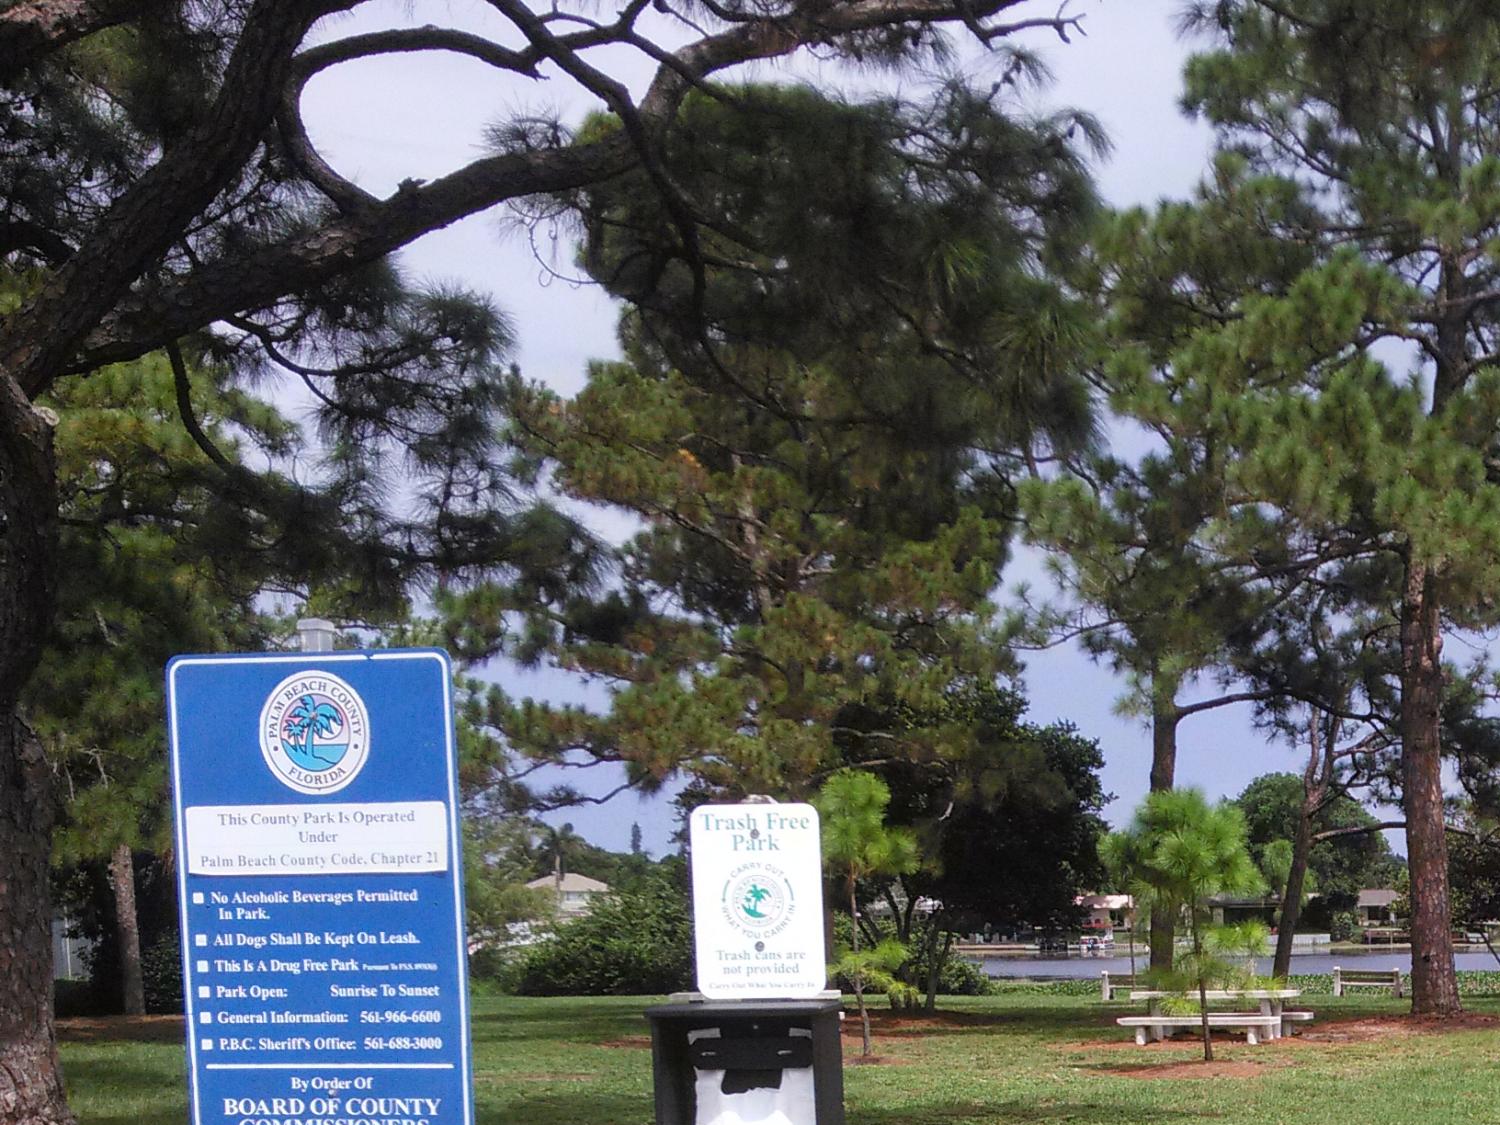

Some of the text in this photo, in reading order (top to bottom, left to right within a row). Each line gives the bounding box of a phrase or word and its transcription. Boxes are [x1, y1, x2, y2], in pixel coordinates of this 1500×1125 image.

[269, 681, 361, 738] PALM BEACH COUNTY
[288, 767, 346, 784] FLORIDA
[218, 810, 415, 827] This County Park Is Operated
[700, 812, 810, 830] Trash Free
[298, 831, 338, 843] Under
[732, 834, 780, 851] Park
[200, 855, 234, 868] Palm
[237, 854, 276, 867] Beach
[280, 854, 326, 869] County
[371, 851, 422, 867] Chapter
[426, 851, 439, 864] 21
[730, 862, 785, 878] CARRY OUT
[211, 889, 418, 905] No Alcoholic Beverages Permitted
[218, 908, 270, 920] In Park.
[721, 905, 740, 930] WHAT
[742, 929, 761, 940] YOU
[764, 915, 793, 939] CARRY
[788, 904, 796, 915] IN
[213, 932, 421, 949] All Dogs Shall Be Kept On Leash.
[714, 949, 806, 961] Trash cans are
[214, 960, 241, 972] This
[243, 960, 254, 972] Is
[257, 960, 268, 972] A
[270, 959, 300, 974] Drug
[303, 959, 329, 971] Free
[331, 959, 359, 971] Park
[722, 962, 800, 977] not provided
[216, 984, 440, 1000] Park Open: Sunrise To Sunset
[217, 1010, 441, 1024] General Information: 561-966-6600
[219, 1037, 443, 1050] P.B.C. Sheriff's Office: 561-688-3000
[291, 1076, 374, 1092] By Order Of
[223, 1098, 441, 1116] BOARD OF COUNTY
